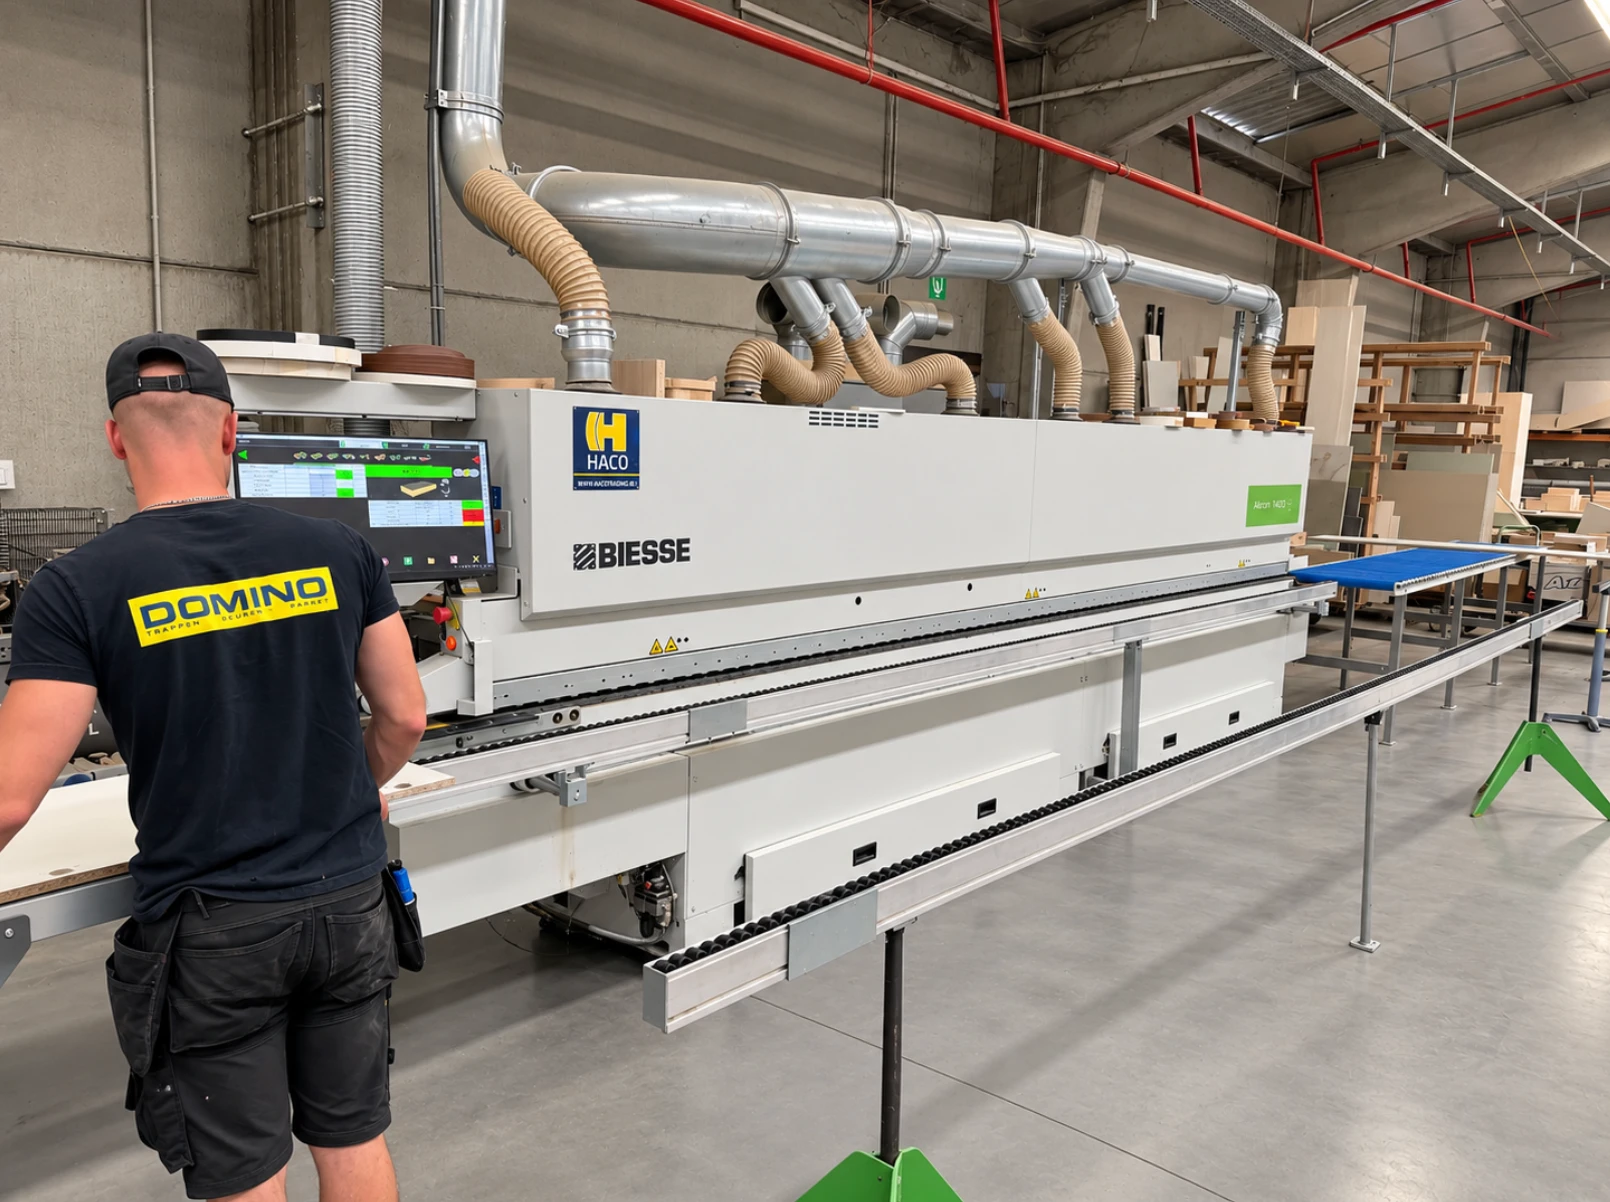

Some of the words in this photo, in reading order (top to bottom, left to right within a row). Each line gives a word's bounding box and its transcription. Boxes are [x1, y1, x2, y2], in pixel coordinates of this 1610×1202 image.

[587, 454, 629, 470] HACO
[598, 538, 691, 569] BIESSE
[139, 576, 328, 630] DOMINO
[146, 620, 200, 637] TRAPPEN
